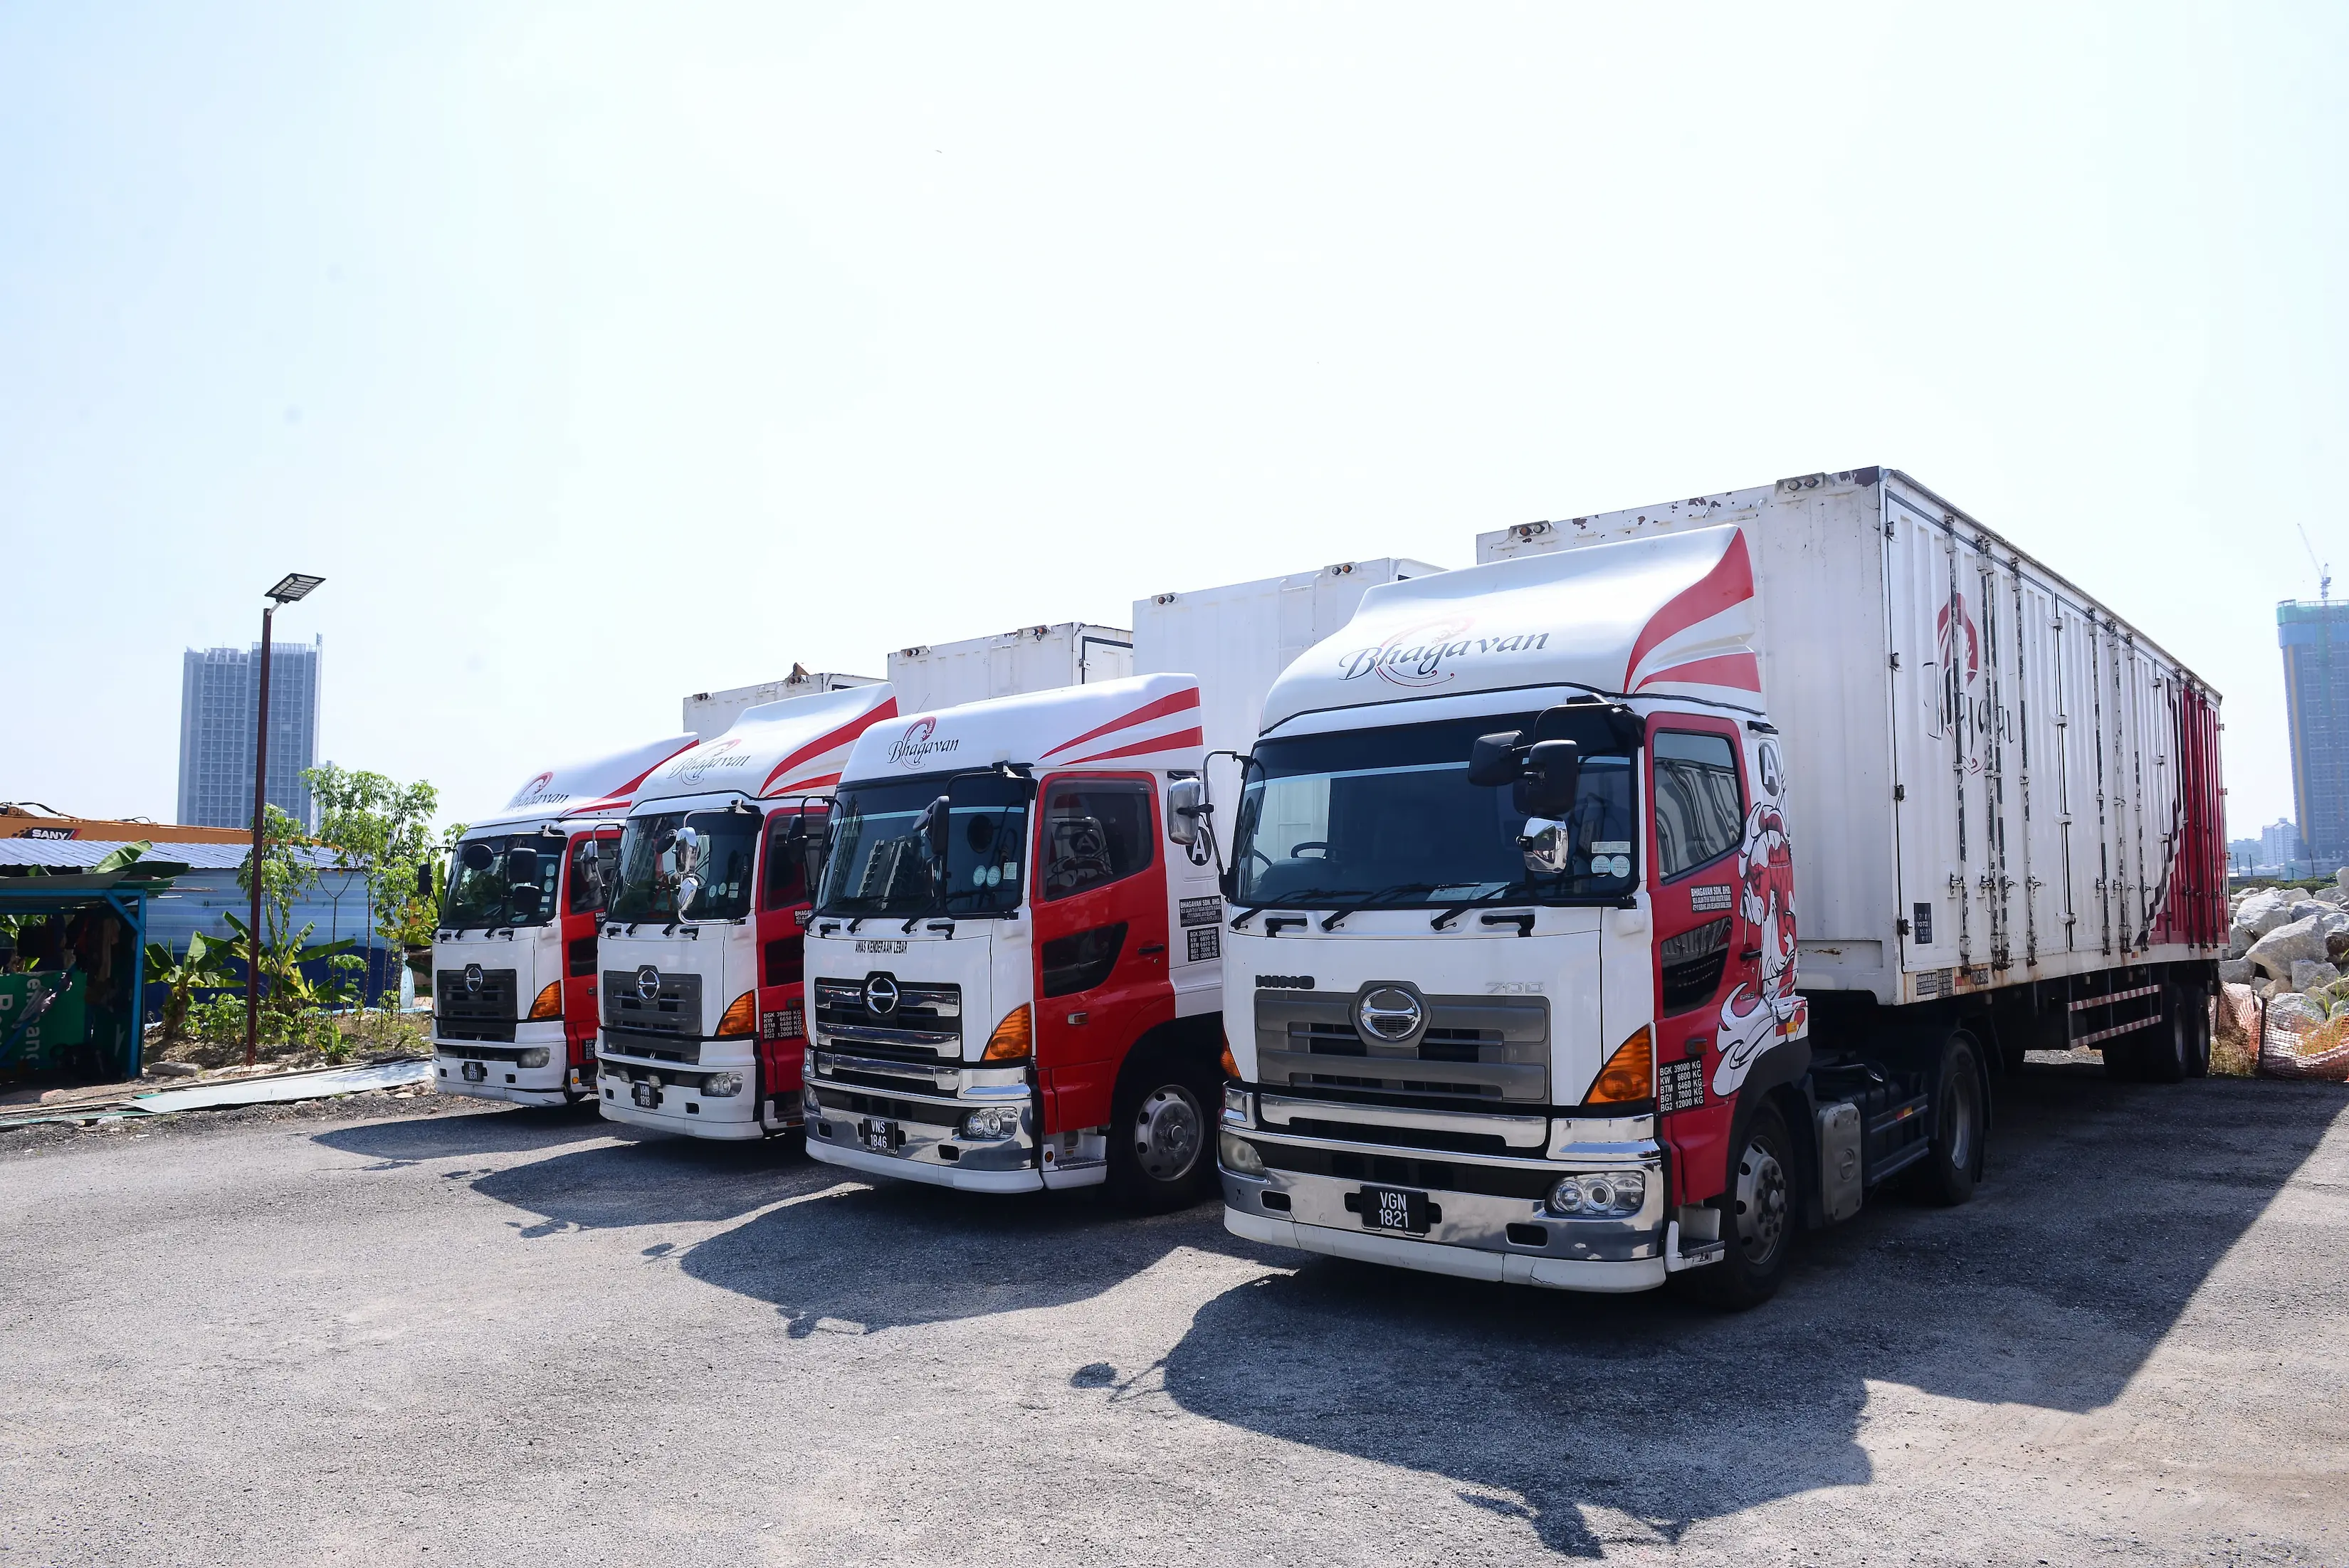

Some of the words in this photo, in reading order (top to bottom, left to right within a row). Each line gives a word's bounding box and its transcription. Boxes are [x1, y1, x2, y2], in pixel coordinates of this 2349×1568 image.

[1338, 632, 1550, 680] Bhagavan
[887, 739, 960, 764] Bhagavan
[1764, 747, 1779, 786] A
[32, 829, 68, 840] SANY
[1192, 829, 1207, 861] A
[1691, 887, 1713, 898] BHAGAVAN
[1180, 900, 1202, 908] BHAGAVAN
[893, 941, 908, 954] LEBAR
[1256, 975, 1315, 989] HINO
[1485, 982, 1545, 994] 700
[1660, 1066, 1672, 1076] BGK
[1674, 1063, 1690, 1073] 39000
[1692, 1061, 1701, 1069] KG
[1660, 1075, 1671, 1085] KW
[1677, 1071, 1691, 1081] 6600
[640, 1085, 650, 1095] VHN
[1660, 1084, 1673, 1094] BTM
[1678, 1080, 1691, 1090] 6460
[1693, 1078, 1702, 1087] KG
[1660, 1093, 1672, 1103] BG1
[1678, 1089, 1691, 1099] 7000
[1693, 1087, 1703, 1096] KG
[1660, 1103, 1673, 1112] BG2
[1676, 1098, 1692, 1108] 12000
[1694, 1095, 1703, 1105] KG
[871, 1120, 886, 1134] VNS
[871, 1134, 887, 1148] 1846
[1380, 1191, 1407, 1211] VGN
[1379, 1209, 1409, 1228] 1821
